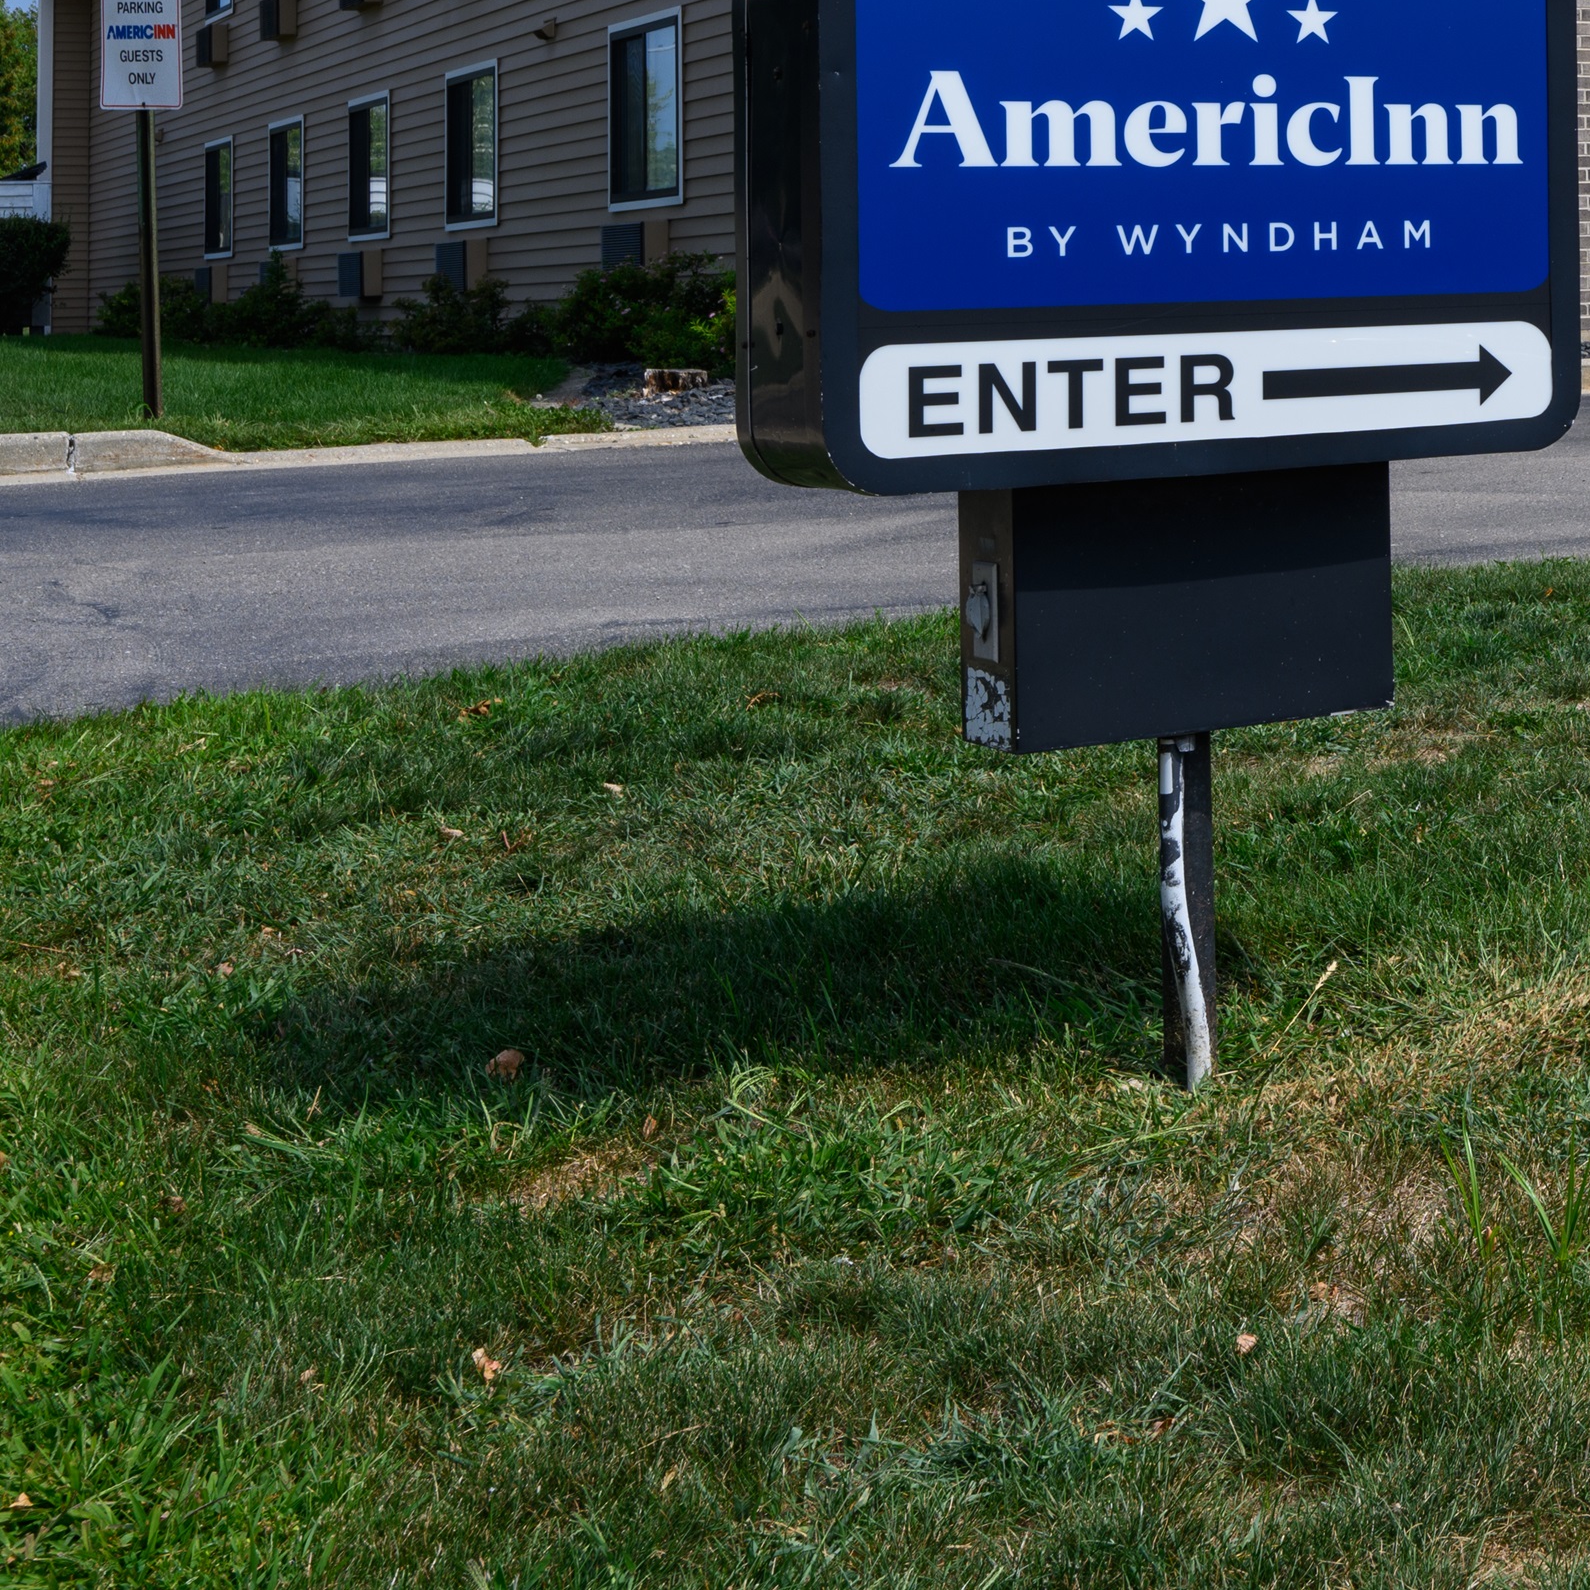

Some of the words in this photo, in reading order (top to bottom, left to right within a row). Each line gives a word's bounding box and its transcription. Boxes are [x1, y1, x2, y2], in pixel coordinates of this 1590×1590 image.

[117, 0, 163, 14] PARKING
[106, 24, 176, 40] AMERICINN
[119, 49, 164, 63] GUESTS
[128, 72, 156, 85] ONLY
[889, 70, 1523, 168] AmericInn
[1007, 226, 1076, 258] BY
[1116, 220, 1433, 256] WYNDHAM
[907, 353, 1236, 439] ENTER
